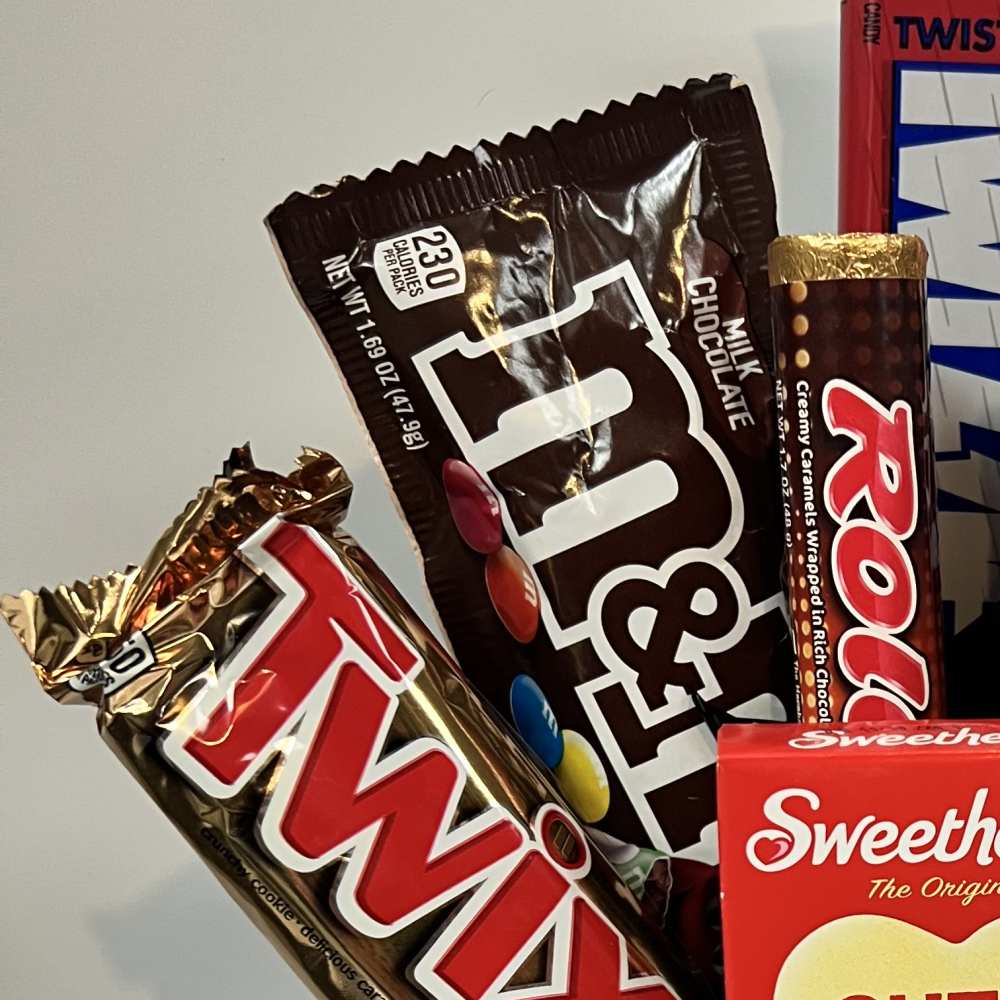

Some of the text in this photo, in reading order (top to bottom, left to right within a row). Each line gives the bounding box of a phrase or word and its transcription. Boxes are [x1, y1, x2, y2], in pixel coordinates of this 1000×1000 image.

[381, 248, 407, 295] PER PACK
[392, 239, 423, 298] CALORIES
[411, 231, 460, 289] 230
[321, 253, 430, 451] NET WT 1.69 OZ (47.9g)
[686, 276, 755, 433] CHOCOLATE
[721, 317, 764, 381] MILK
[796, 379, 812, 446] Creamy
[801, 448, 818, 528] Caramels
[805, 529, 824, 607] Wrapped
[811, 608, 825, 627] in
[812, 629, 828, 665] Rich
[867, 878, 912, 901] The
[249, 877, 297, 923] cookie
[299, 924, 358, 982] delicious
